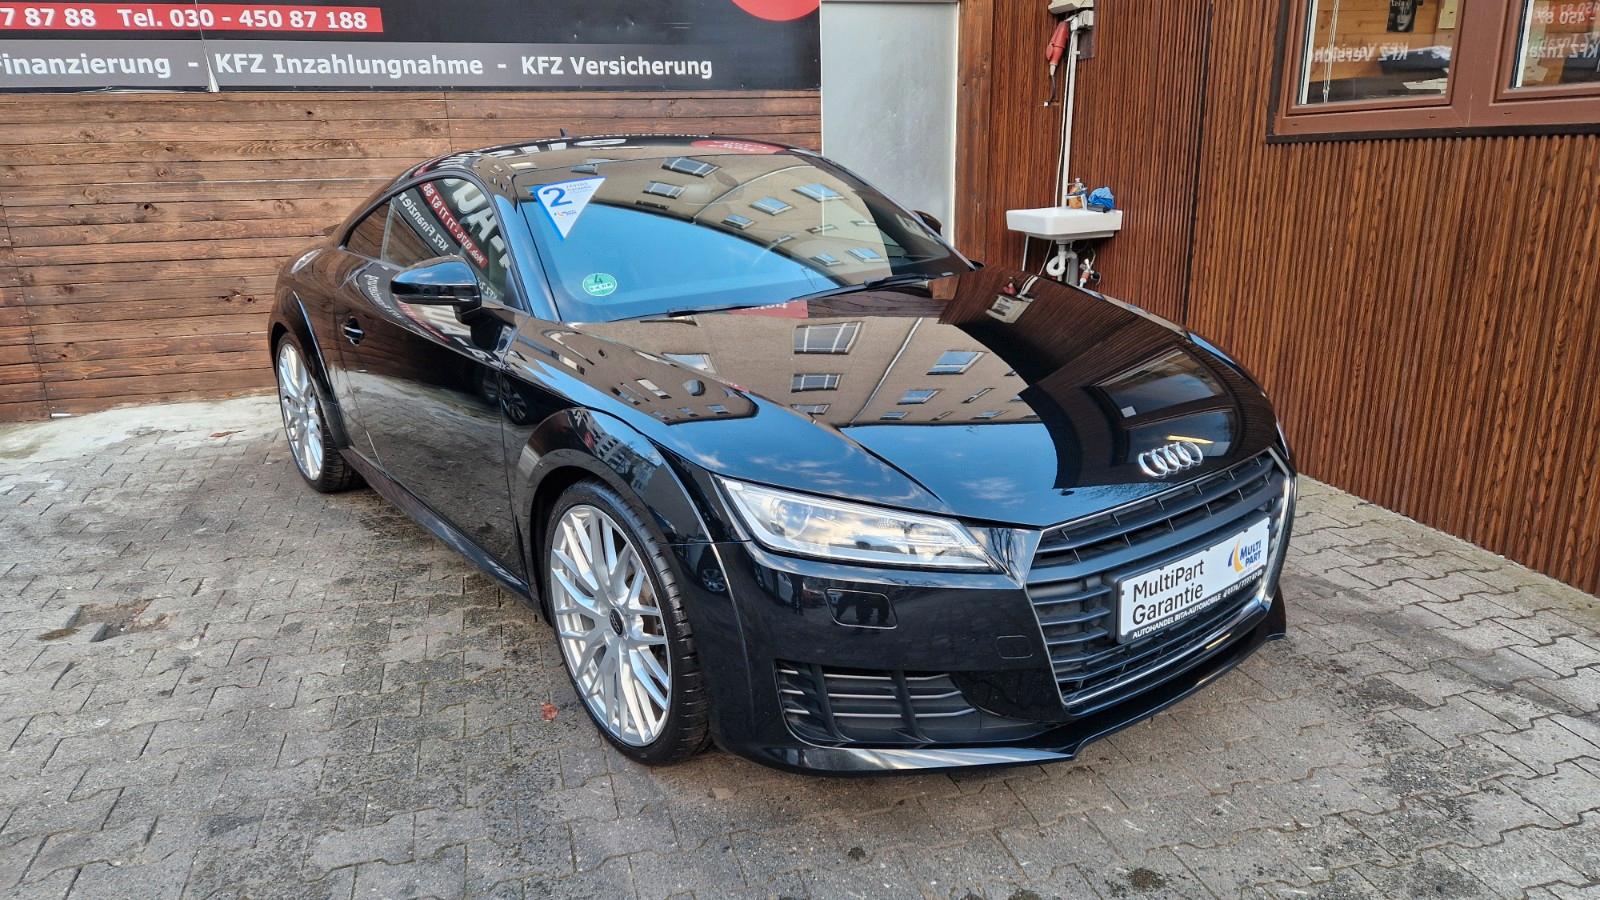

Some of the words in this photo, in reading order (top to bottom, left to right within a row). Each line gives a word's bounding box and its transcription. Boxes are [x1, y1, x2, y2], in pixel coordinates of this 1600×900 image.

[24, 7, 56, 27] 87
[64, 8, 97, 27] 88
[117, 8, 163, 27] Tel.
[169, 8, 214, 28] 030
[238, 9, 283, 28] 450
[290, 10, 317, 28] 87
[327, 11, 367, 29] 188
[0, 52, 170, 79] inanzierung
[215, 53, 266, 74] KFZ
[274, 54, 483, 80] Inzahlungnahme
[522, 56, 564, 75] KFZ
[569, 56, 713, 79] Versicherung
[543, 187, 573, 208] 2
[594, 274, 603, 284] 4
[1240, 539, 1262, 557] MULTI
[1245, 551, 1262, 567] PART
[1133, 559, 1205, 603] MultiPart
[1132, 583, 1204, 626] Garantie
[1132, 619, 1175, 640] AUTOHANDEL
